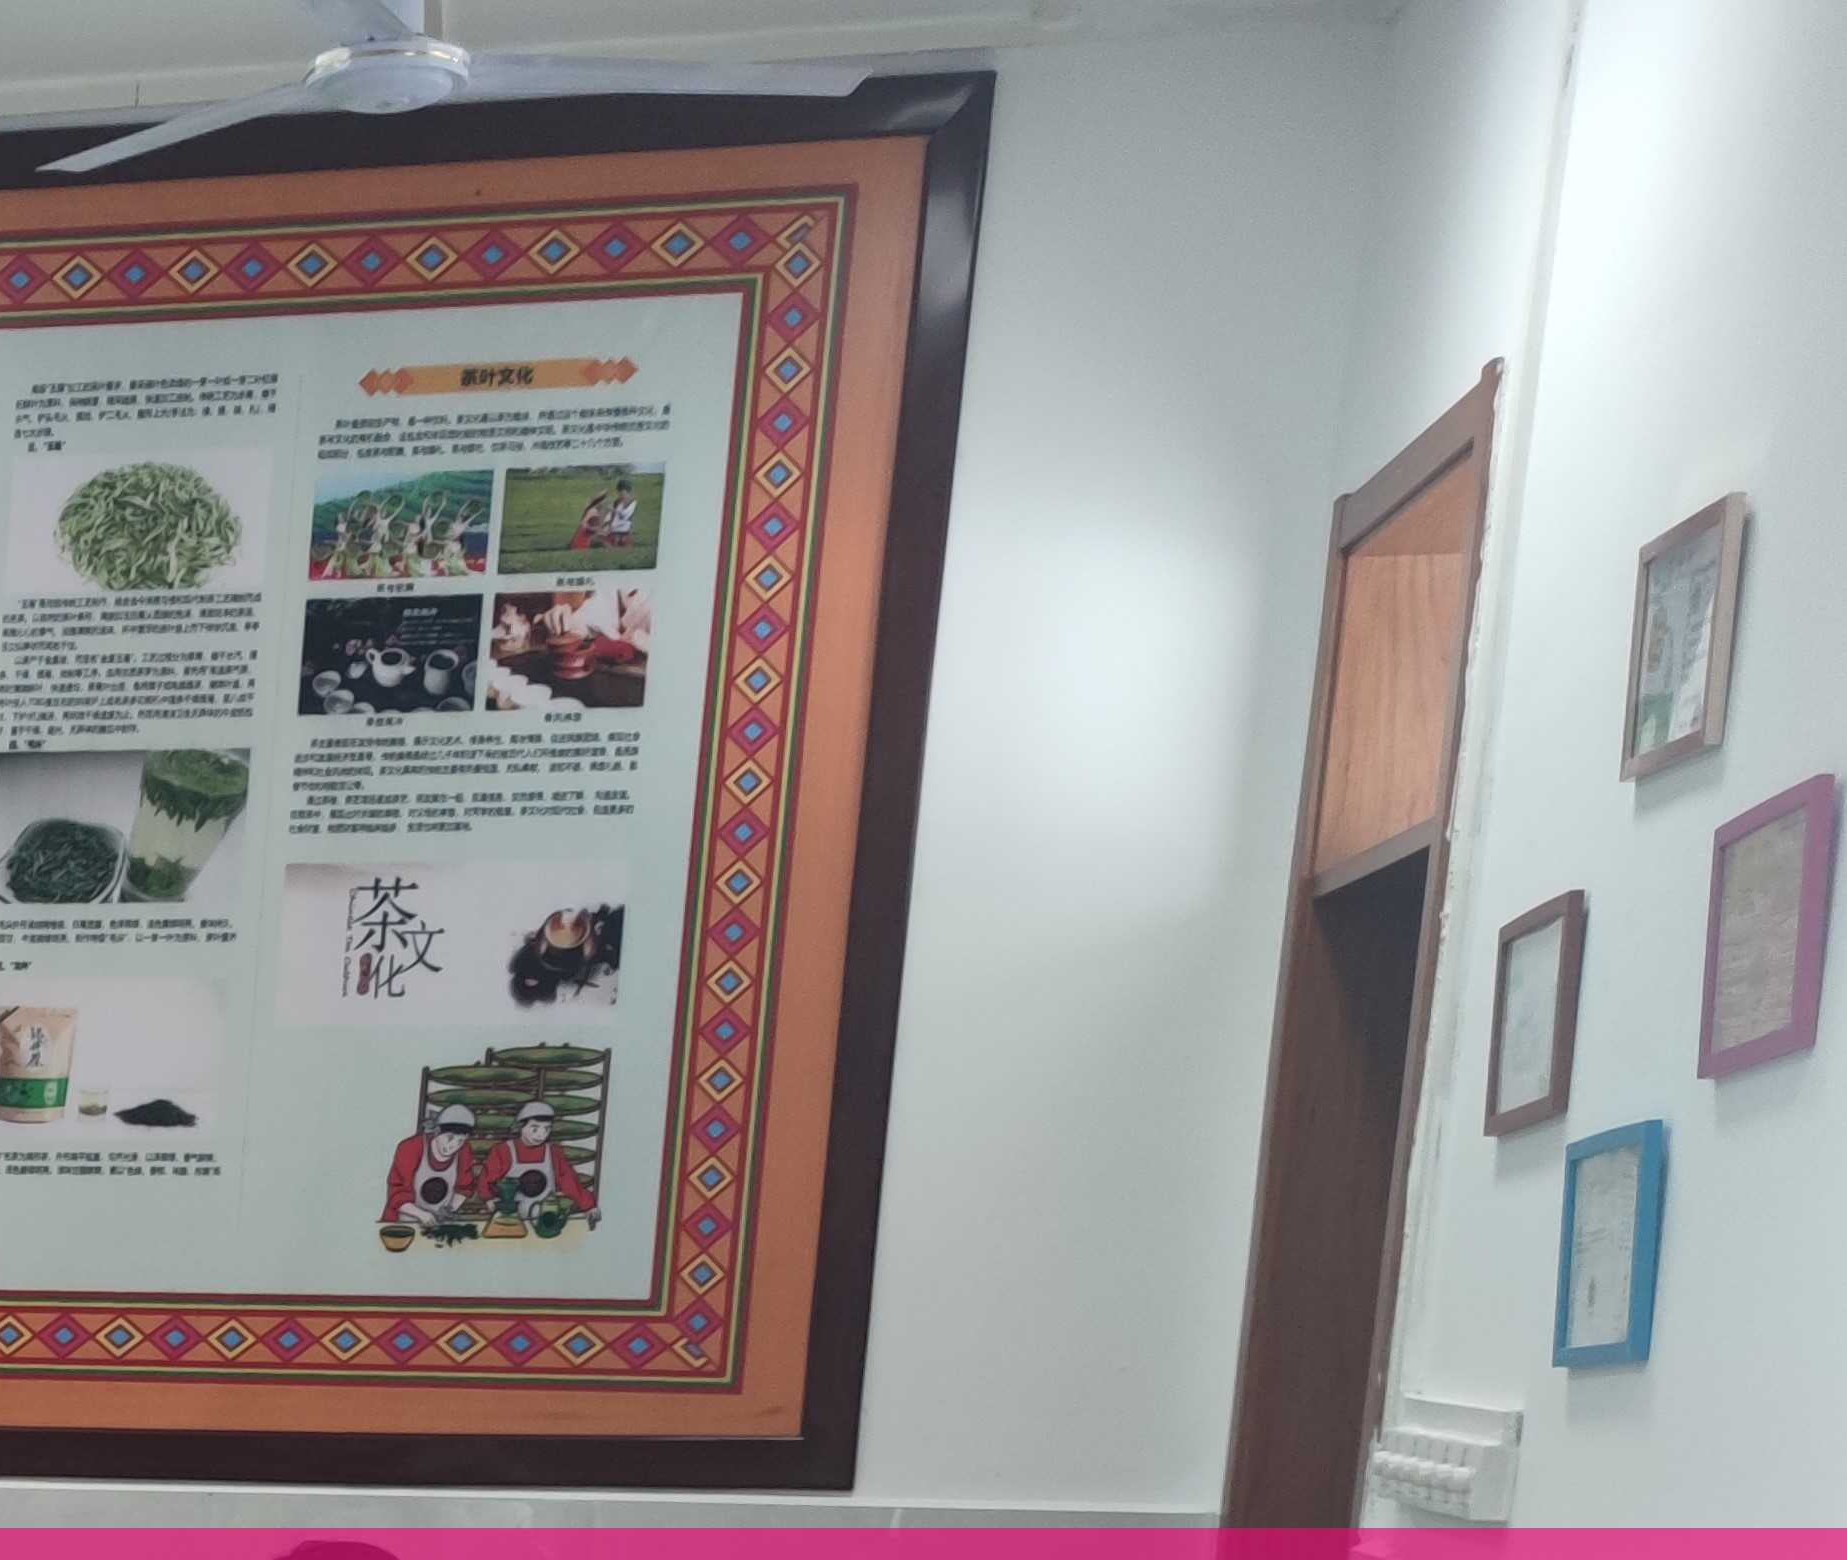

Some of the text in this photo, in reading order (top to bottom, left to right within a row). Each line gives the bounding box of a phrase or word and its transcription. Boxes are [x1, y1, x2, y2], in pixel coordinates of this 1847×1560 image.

[463, 366, 534, 386] 茶叶文化
[354, 876, 445, 999] 茶 文 化
